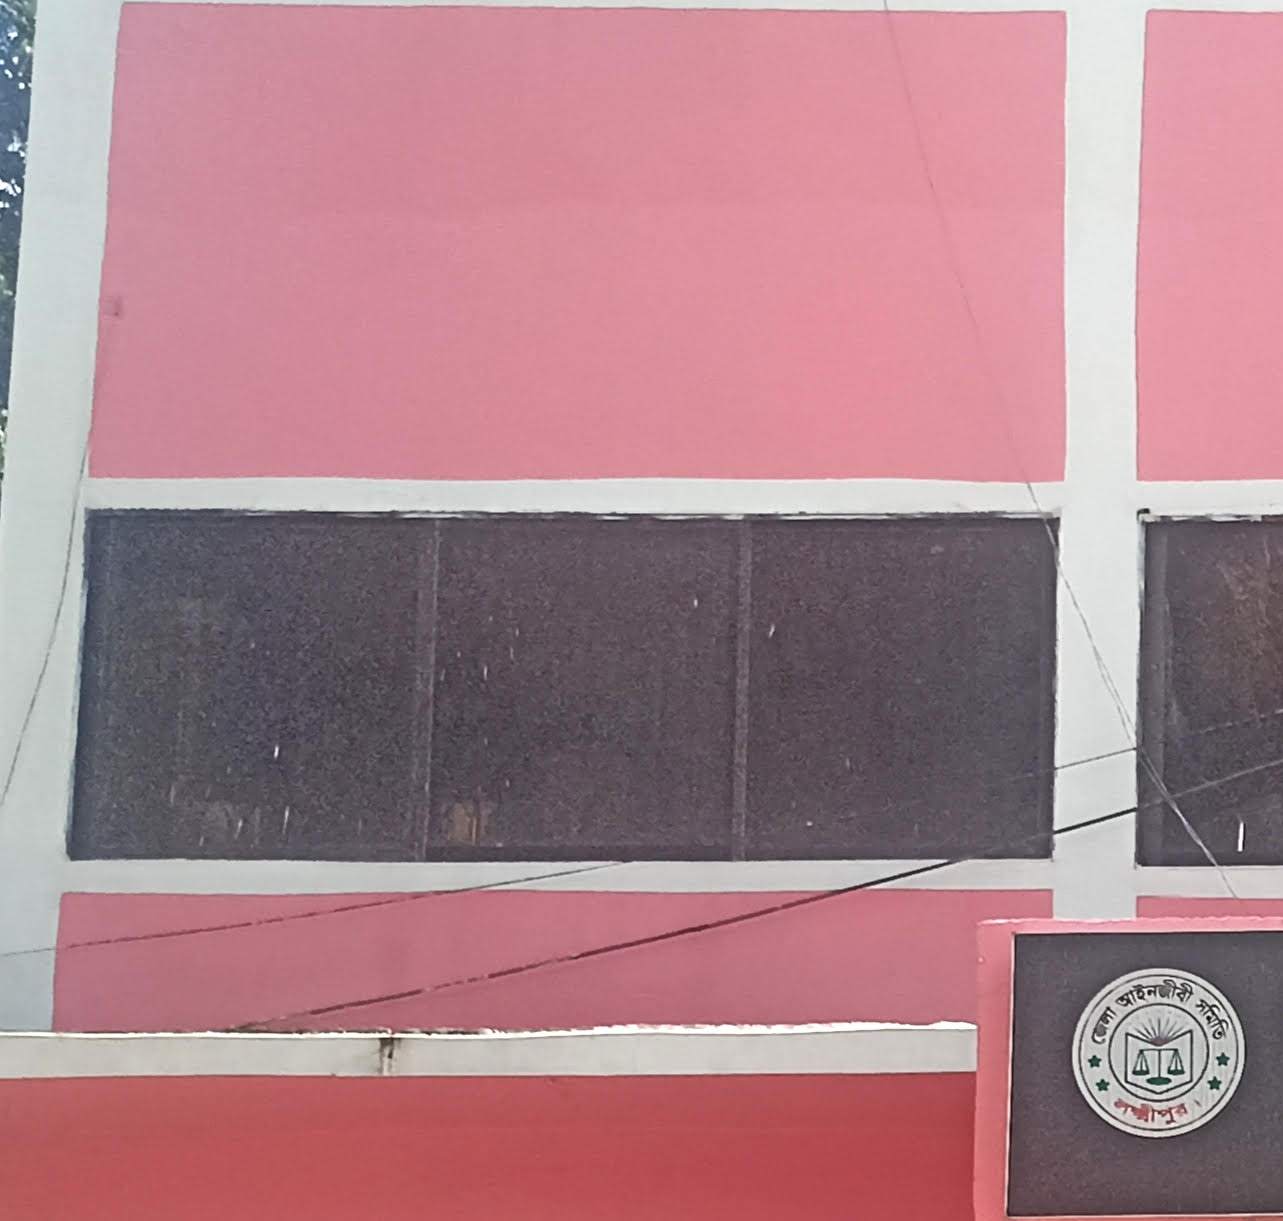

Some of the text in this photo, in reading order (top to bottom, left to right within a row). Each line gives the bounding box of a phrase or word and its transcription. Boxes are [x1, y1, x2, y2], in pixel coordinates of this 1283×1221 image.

[1092, 979, 1230, 1045] জেলা আইনজীবী সমিতি
